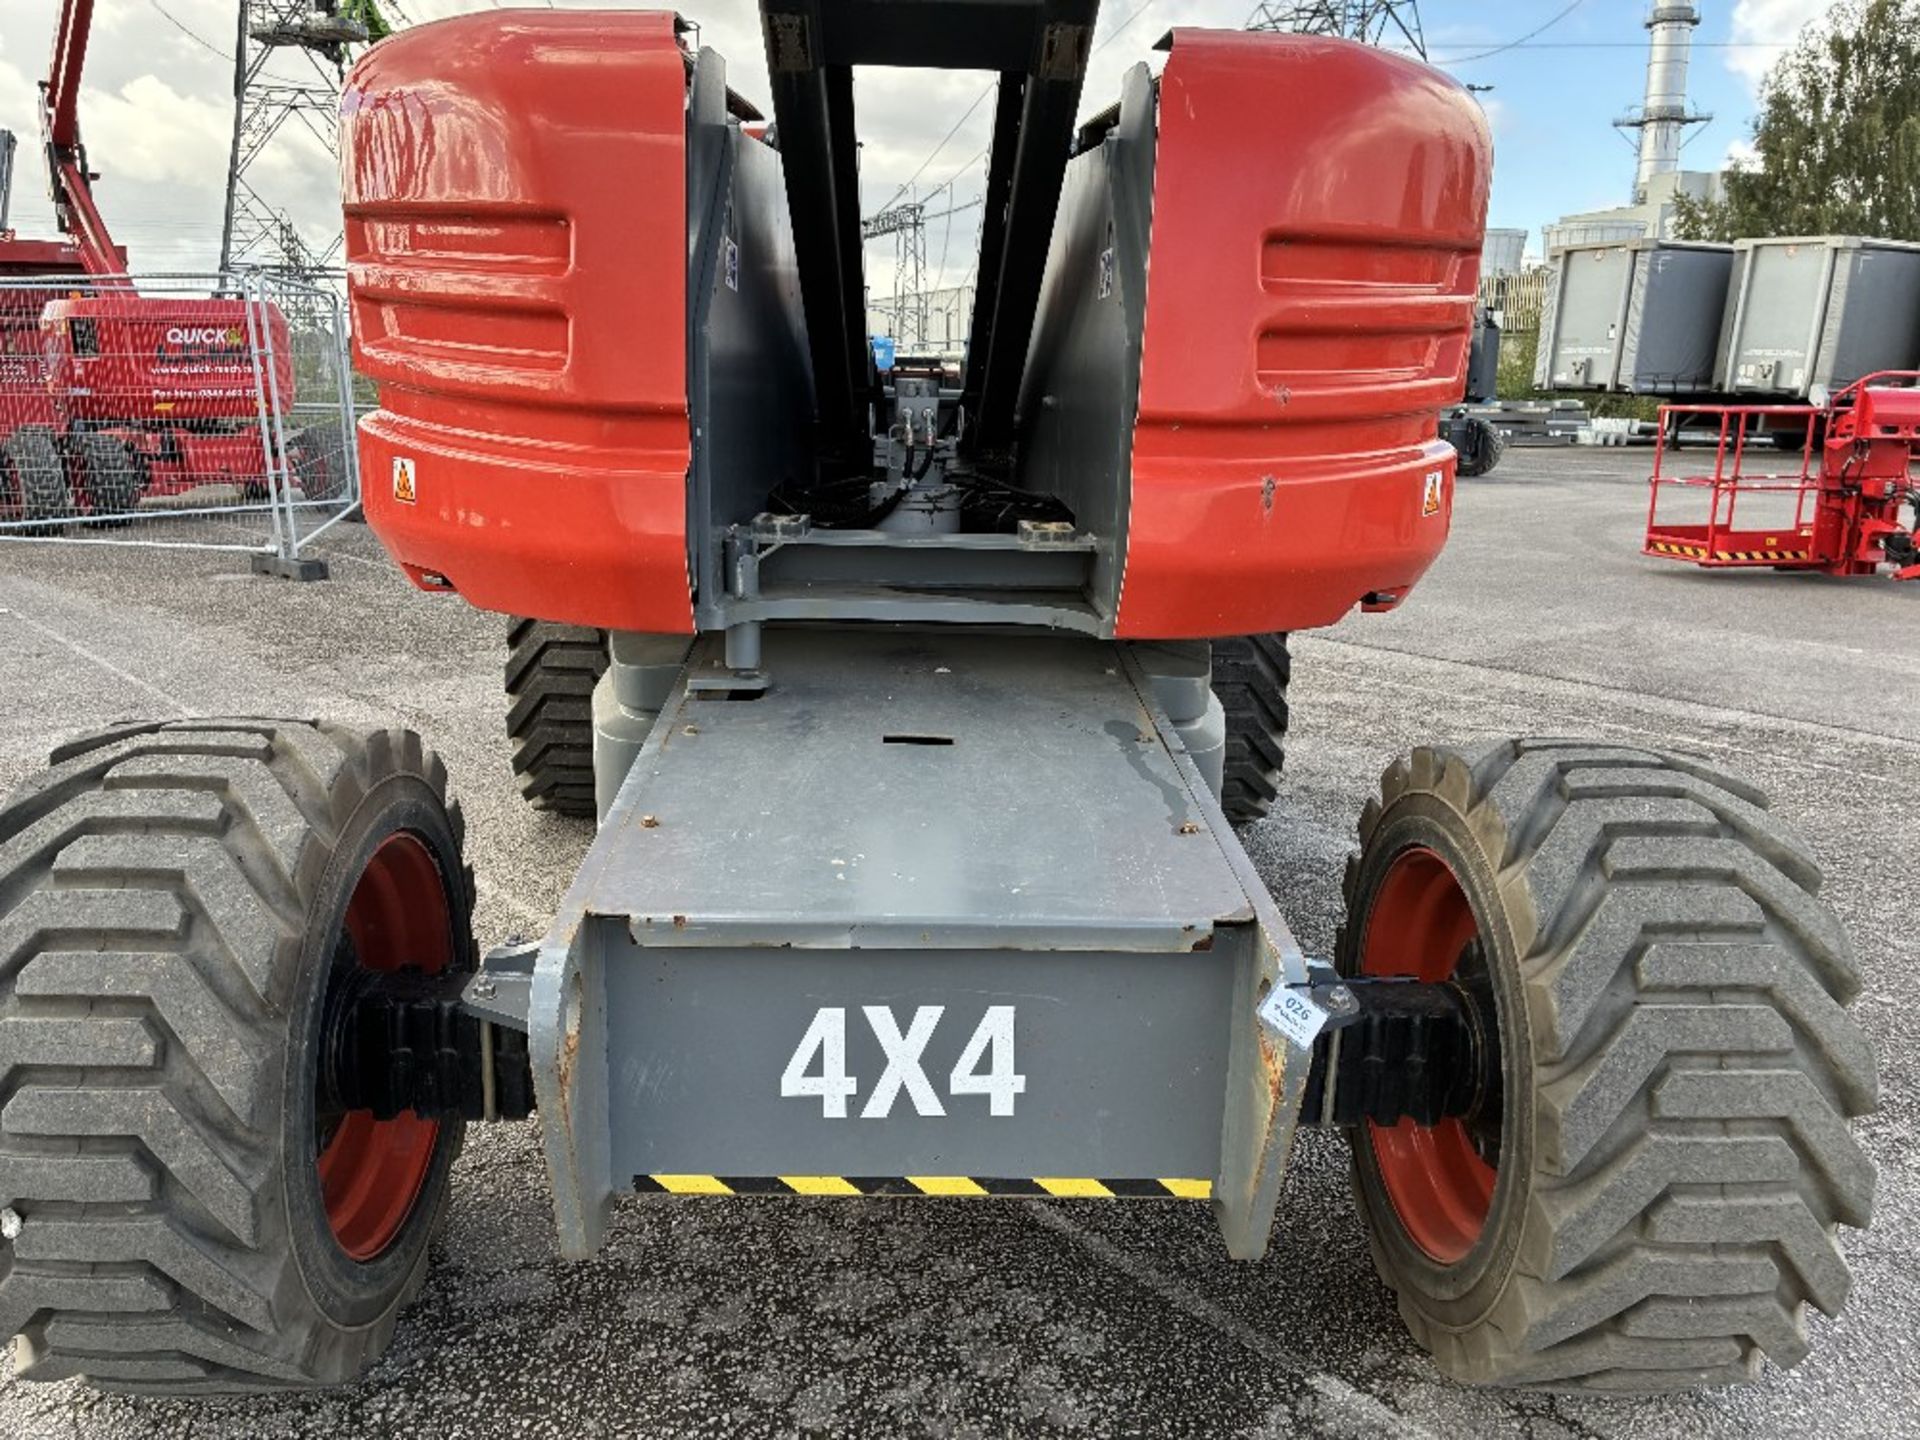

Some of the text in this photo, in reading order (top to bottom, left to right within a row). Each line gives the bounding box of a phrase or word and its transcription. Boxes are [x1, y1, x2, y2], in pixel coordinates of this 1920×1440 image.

[166, 327, 228, 344] QUICK
[1286, 997, 1312, 1021] 026
[780, 1005, 1026, 1118] 4X4
